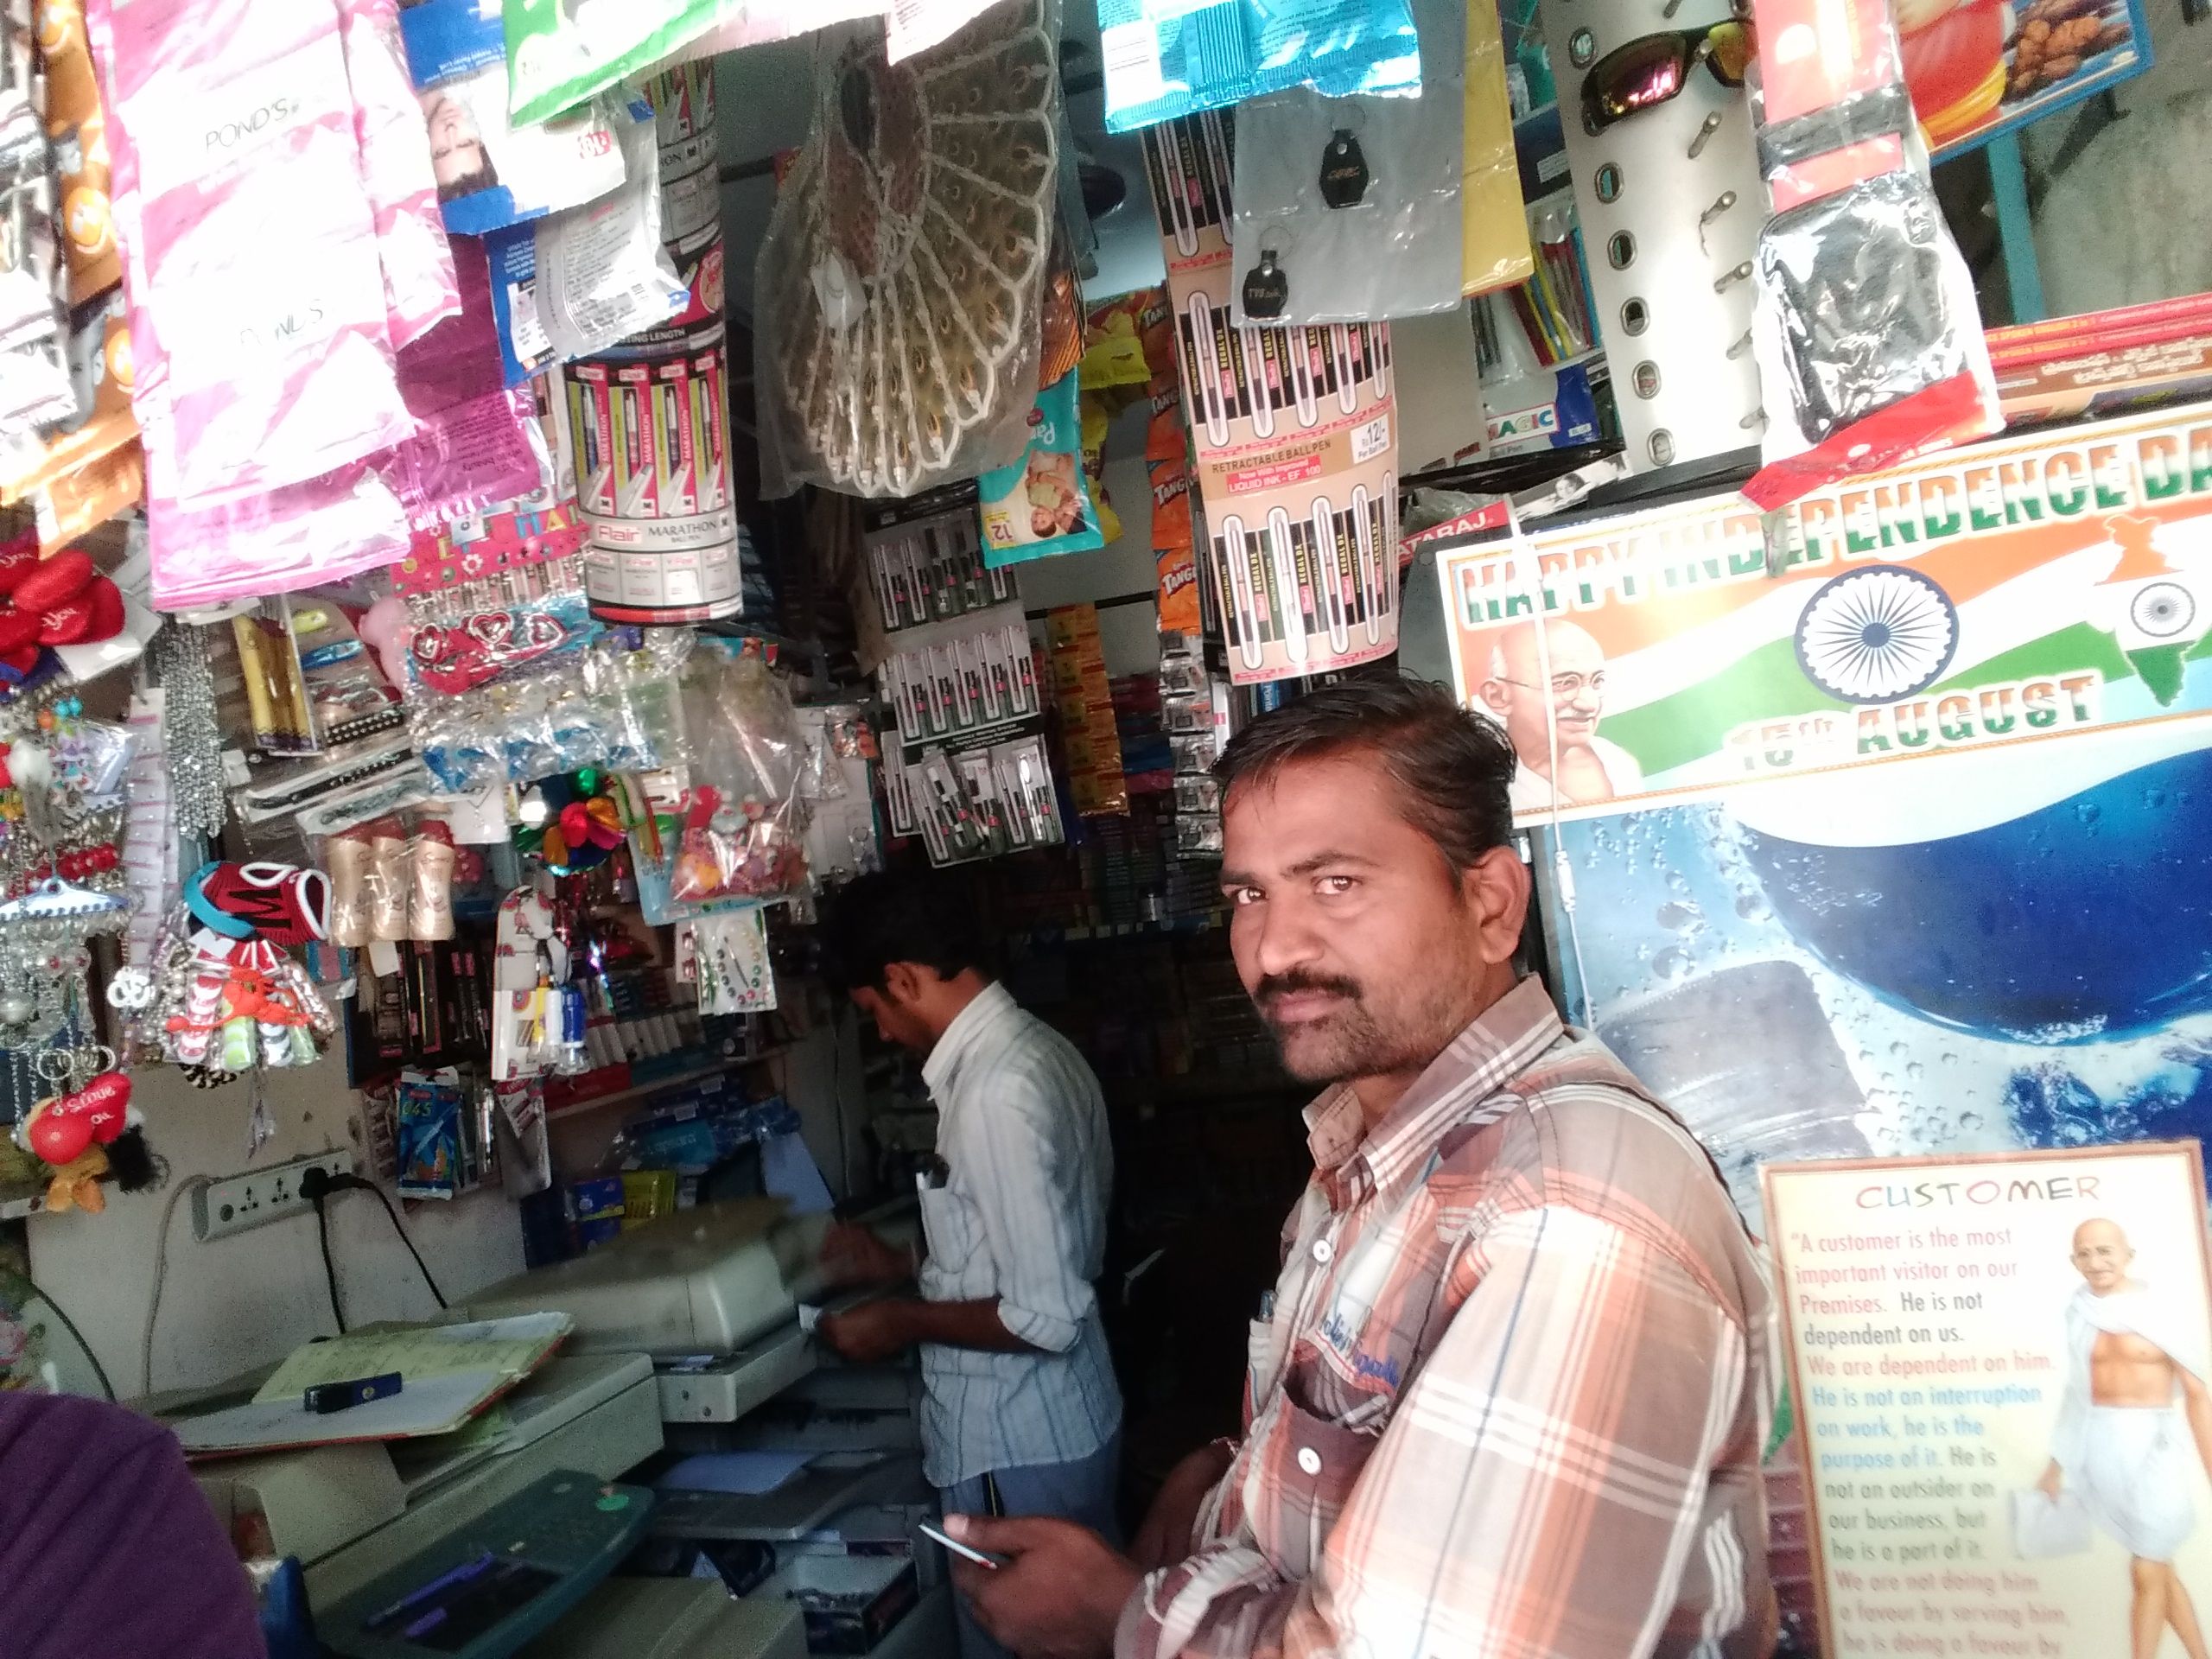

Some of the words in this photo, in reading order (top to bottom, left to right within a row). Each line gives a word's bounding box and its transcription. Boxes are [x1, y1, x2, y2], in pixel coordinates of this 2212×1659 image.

[206, 99, 288, 154] POND'S
[650, 329, 685, 341] LENGTH
[1218, 341, 1229, 369] REGAL
[643, 414, 652, 466] MARATHON
[683, 410, 691, 462] MARATHON
[1212, 450, 1285, 473] RETRACTABLE
[1286, 446, 1312, 461] BALL
[1313, 440, 1331, 453] PEN
[1230, 477, 1262, 493] LIQUID
[1264, 475, 1281, 486] INK
[1287, 470, 1300, 481] EF
[1306, 465, 1321, 477] 100
[515, 503, 578, 539] HAI
[598, 525, 640, 542] Flair
[648, 519, 717, 536] MARATHON
[991, 523, 1013, 540] 12
[1397, 512, 1486, 556] ATARAJ
[1296, 543, 1303, 556] DX
[1338, 533, 1345, 545] DX
[1250, 552, 1258, 564] DX
[1298, 557, 1306, 583] REGAL
[1339, 547, 1348, 574] REGAL
[1252, 566, 1262, 591] REGAL
[1462, 537, 1640, 623] HAPPY
[1730, 718, 1834, 771] 15th
[1857, 676, 2094, 754] AUGUST
[1856, 1176, 2101, 1209] CUSTOMER
[1819, 1234, 1901, 1252] customer
[1909, 1230, 1923, 1249] is
[1929, 1227, 1959, 1247] the
[1967, 1228, 2012, 1246] most
[1796, 1265, 1887, 1288] important
[1894, 1262, 1949, 1281] visitor
[1957, 1264, 1980, 1279] on
[1987, 1262, 2018, 1277] our
[1800, 1294, 1887, 1314] Premises.
[1901, 1293, 1925, 1312] He
[1932, 1294, 1946, 1309] is
[1954, 1292, 1983, 1309] not
[1804, 1323, 1902, 1349] dependent
[1909, 1328, 1930, 1343] on
[1939, 1326, 1965, 1342] us.
[1808, 1356, 1835, 1376] We
[1842, 1360, 1872, 1376] are
[1879, 1352, 1977, 1379] dependent
[1984, 1356, 2005, 1370] on
[2013, 1350, 2056, 1370] him.
[1814, 1388, 1836, 1407] He
[1845, 1388, 1858, 1407] is
[1866, 1389, 1893, 1406] not
[1901, 1389, 1923, 1406] an
[1929, 1384, 2041, 1408] interruption
[1817, 1423, 1839, 1435] on
[1847, 1416, 1897, 1438] work,
[1904, 1415, 1927, 1435] he
[1933, 1418, 1948, 1435] is
[1955, 1414, 1983, 1435] the
[1821, 1452, 1894, 1471] purpose
[1902, 1446, 1919, 1467] of
[1949, 1446, 1975, 1466] He
[1981, 1448, 1997, 1465] is
[1825, 1483, 1853, 1498] not
[1861, 1484, 1883, 1497] an
[1891, 1477, 1964, 1497] outsider
[1971, 1482, 1995, 1497] on
[1829, 1515, 1859, 1529] our
[1955, 1507, 1985, 1528] but
[1831, 1538, 1854, 1559] he
[1862, 1540, 1875, 1558] is
[1883, 1547, 1892, 1560] a
[1899, 1544, 1936, 1564] part
[1944, 1537, 1961, 1559] of
[1834, 1571, 1862, 1589] We
[1906, 1574, 1936, 1589] not
[1942, 1571, 1995, 1596] doing
